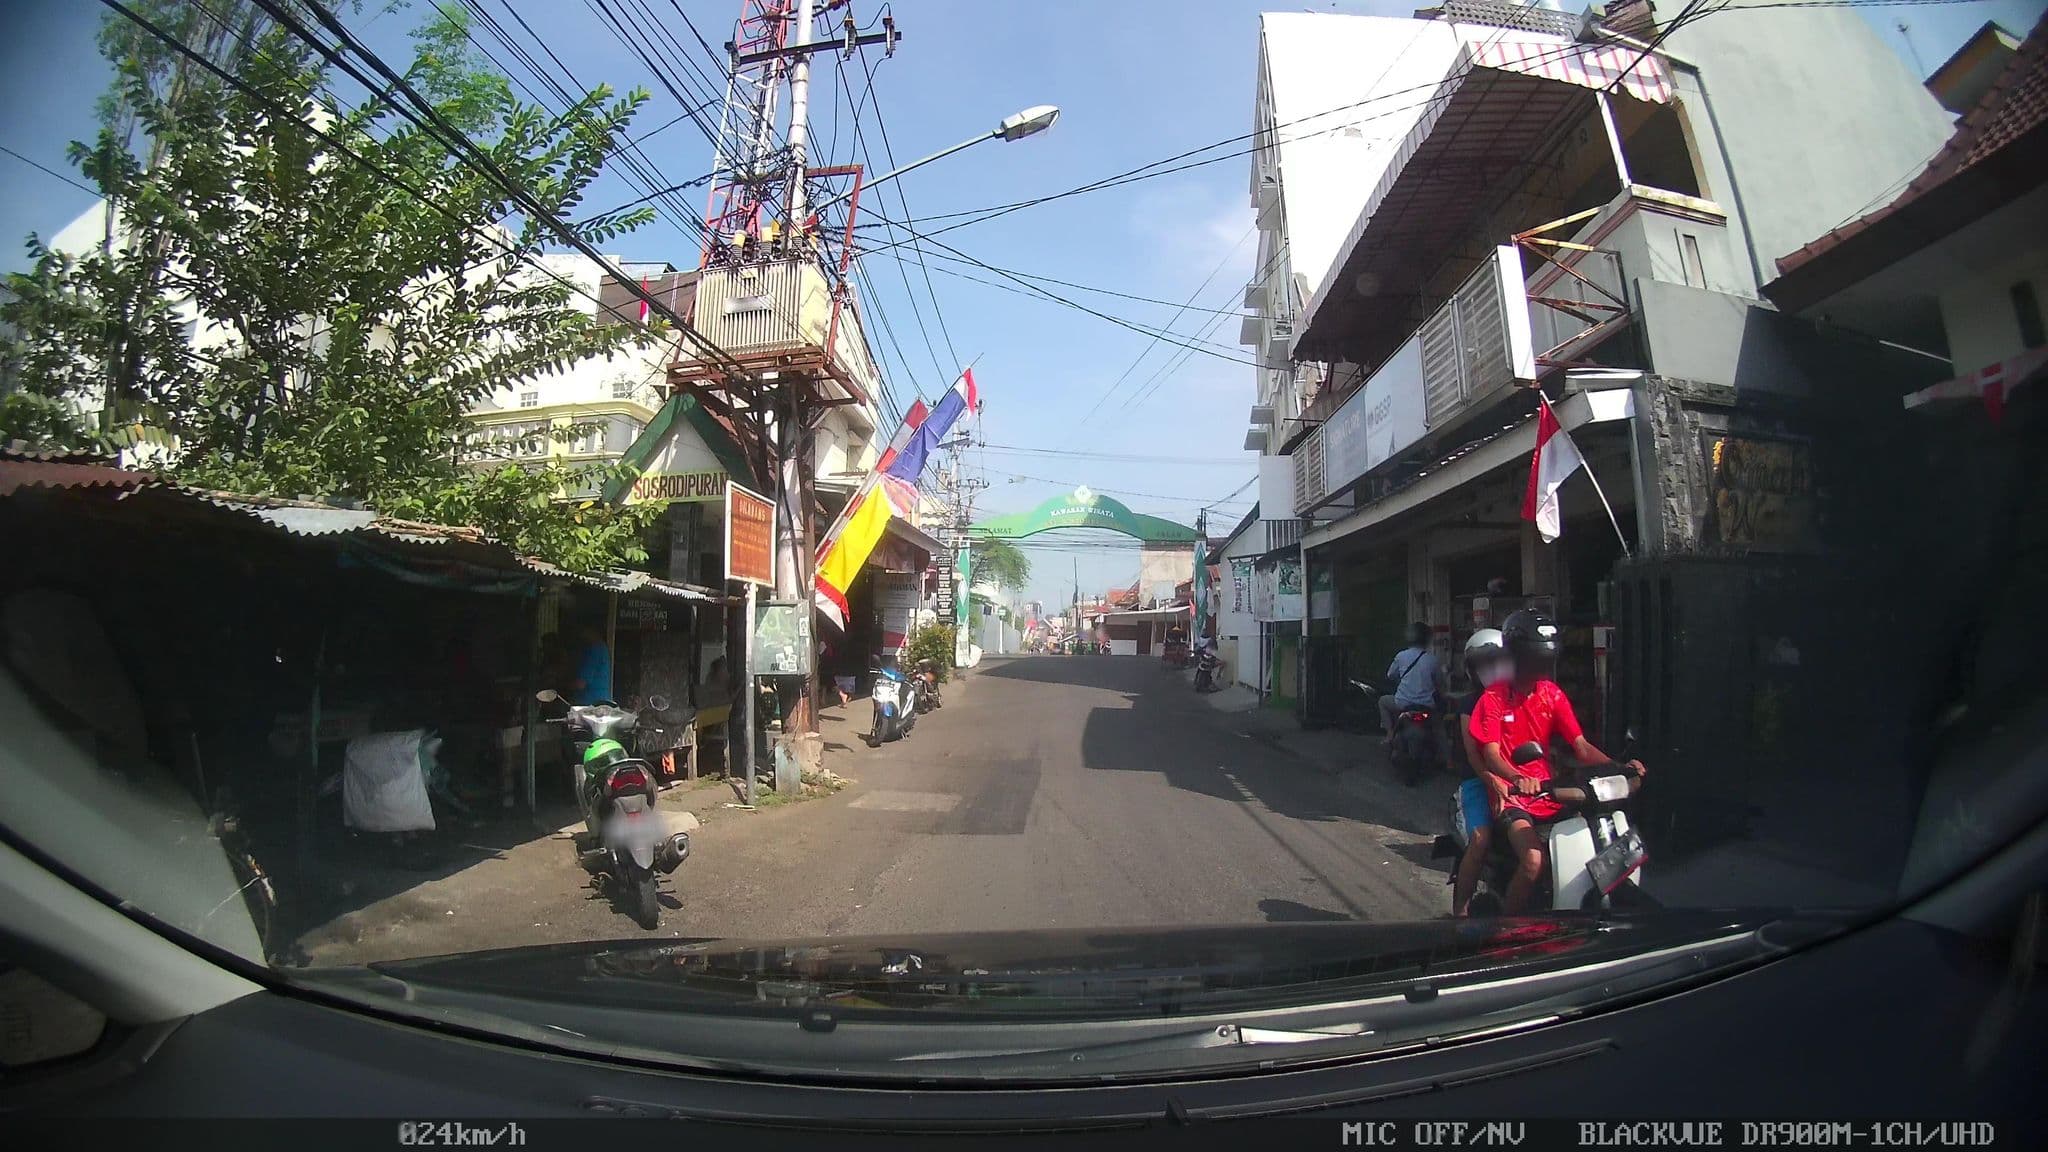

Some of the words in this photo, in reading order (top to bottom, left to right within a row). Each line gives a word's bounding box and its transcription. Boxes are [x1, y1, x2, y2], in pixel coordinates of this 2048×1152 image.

[634, 472, 728, 500] SOSRODIPURAN
[1050, 506, 1085, 517] KAWASAN
[1087, 506, 1114, 518] WISATA
